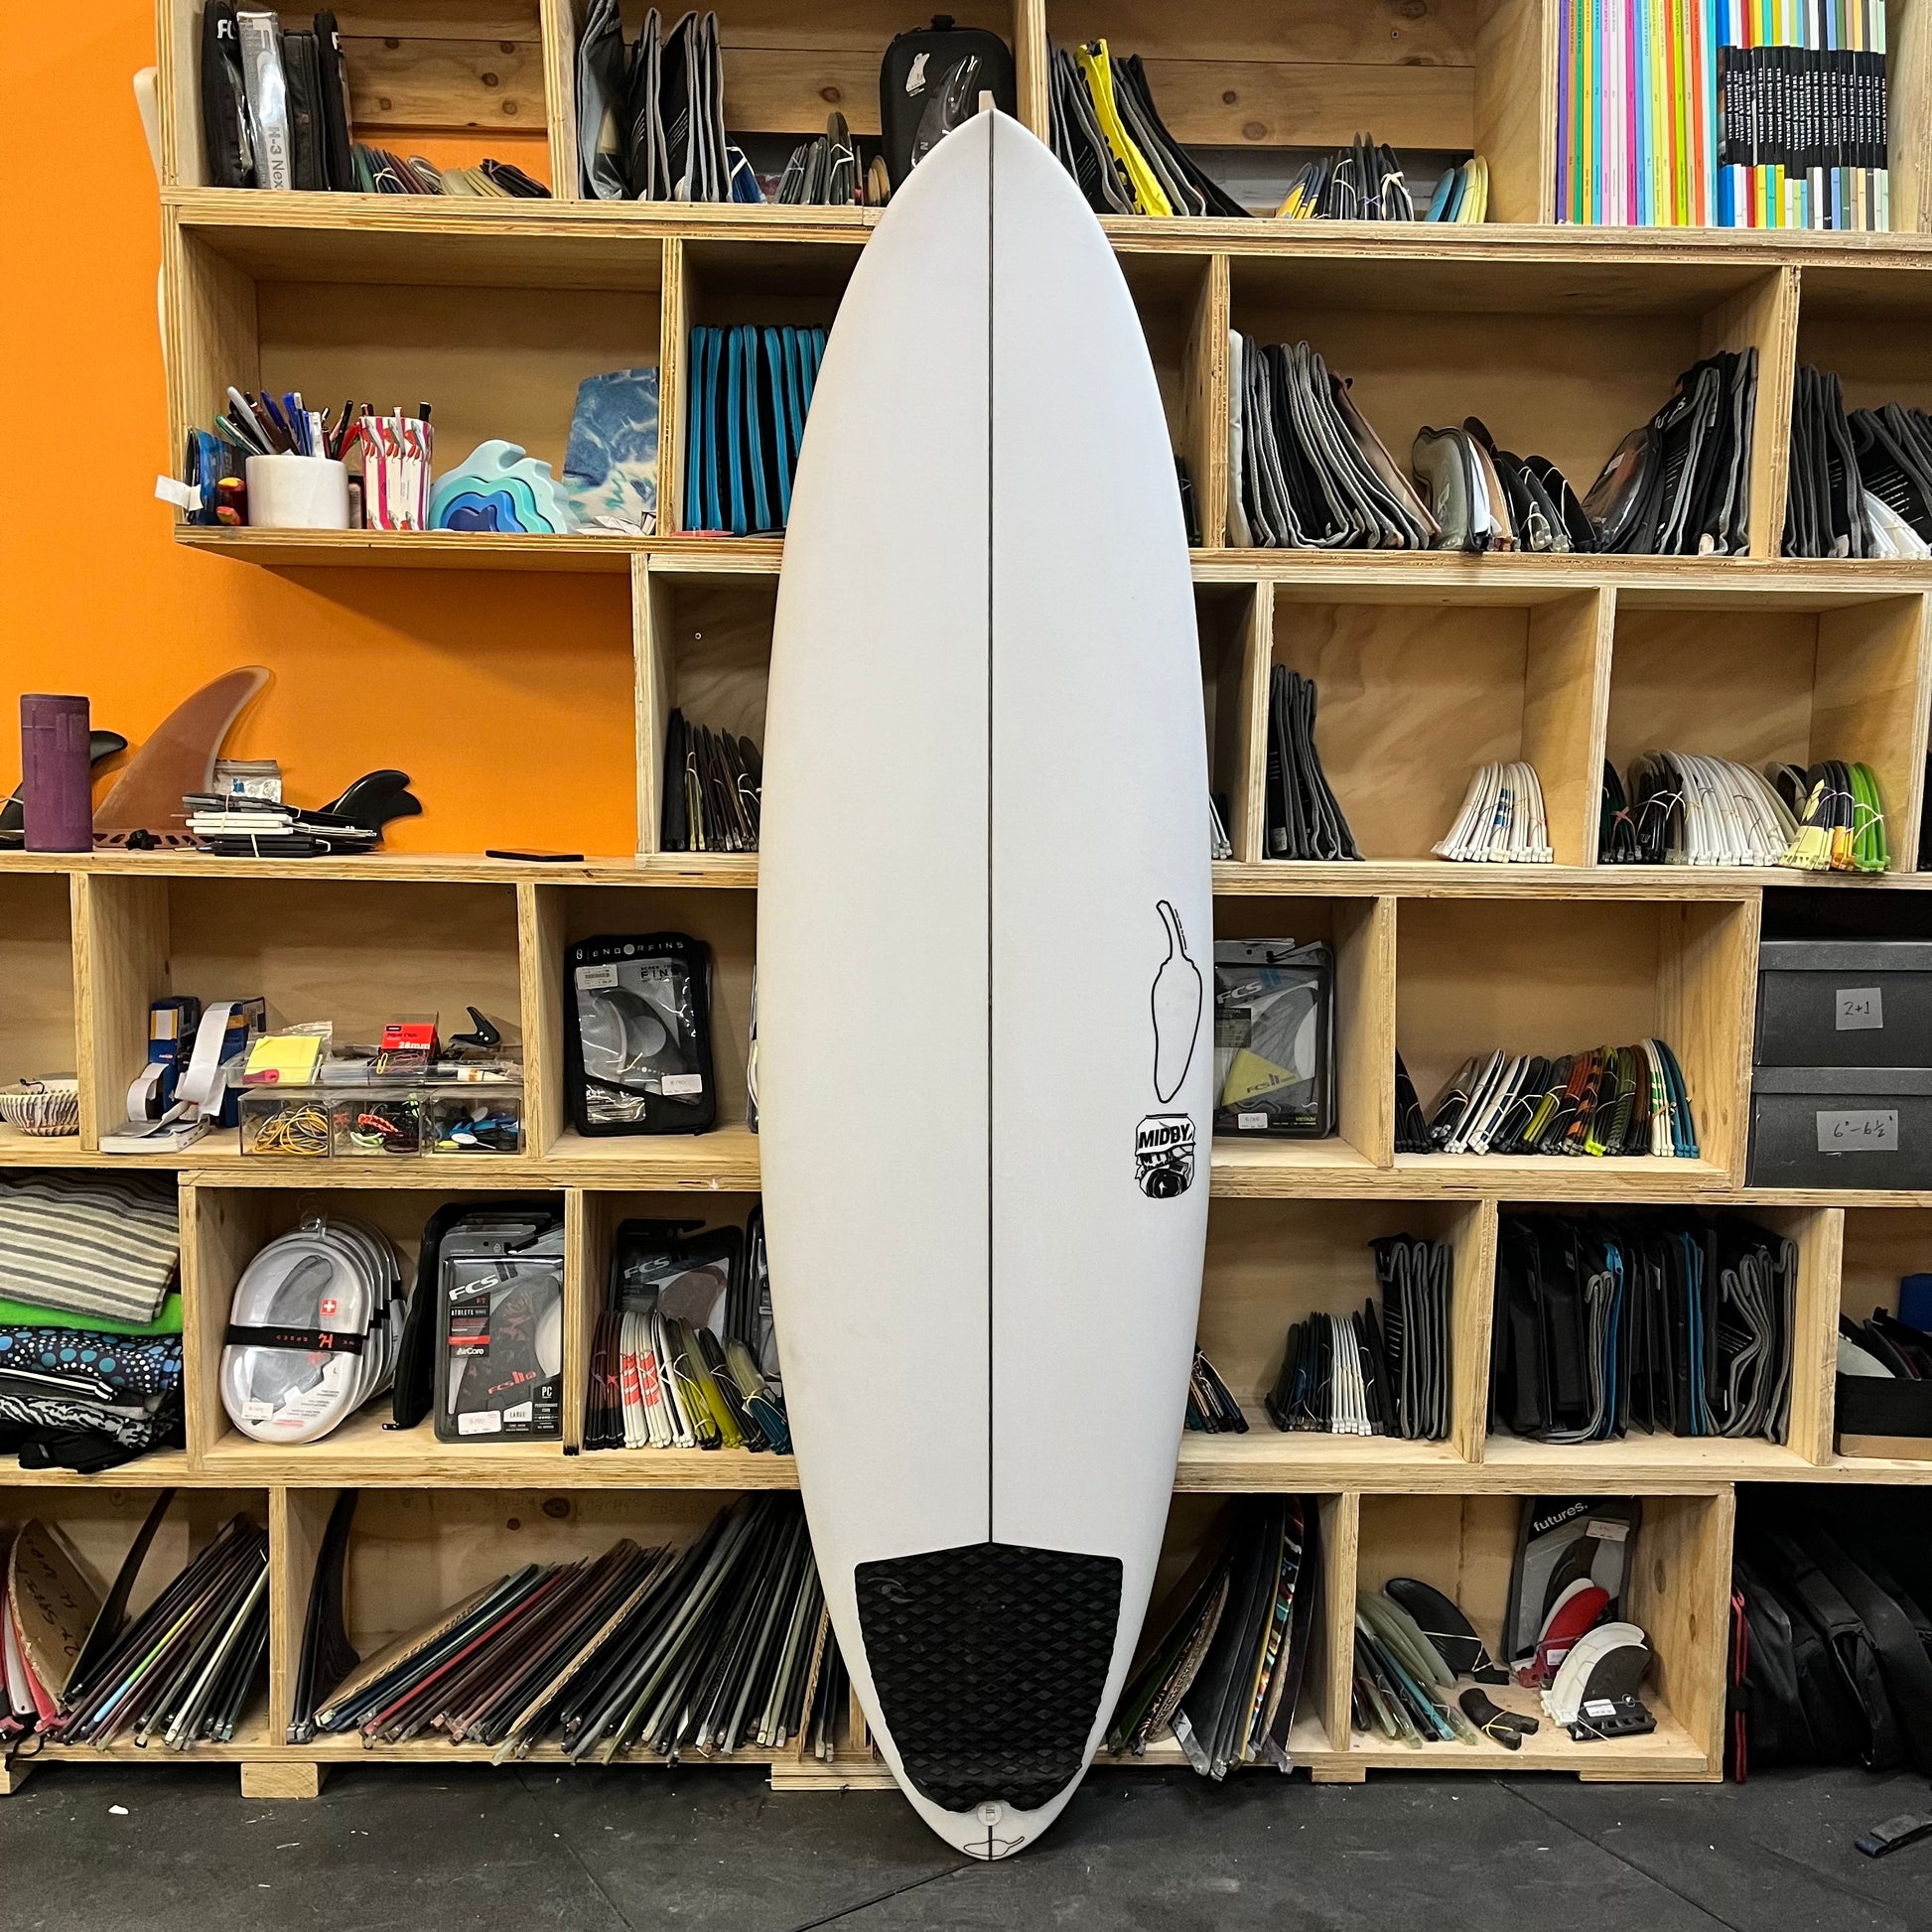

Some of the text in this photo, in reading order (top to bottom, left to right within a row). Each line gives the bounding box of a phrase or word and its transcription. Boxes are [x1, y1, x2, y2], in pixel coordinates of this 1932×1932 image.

[266, 125, 283, 155] H-3
[270, 159, 285, 190] Nex
[1216, 981, 1262, 1004] FCS
[1844, 1001, 1870, 1016] 2+1
[623, 1256, 670, 1280] FCS
[449, 1274, 499, 1302] FCS
[456, 1346, 484, 1355] AirCore
[541, 1386, 553, 1397] PC
[509, 1409, 526, 1418] LARGE
[1533, 1502, 1588, 1532] futures.
